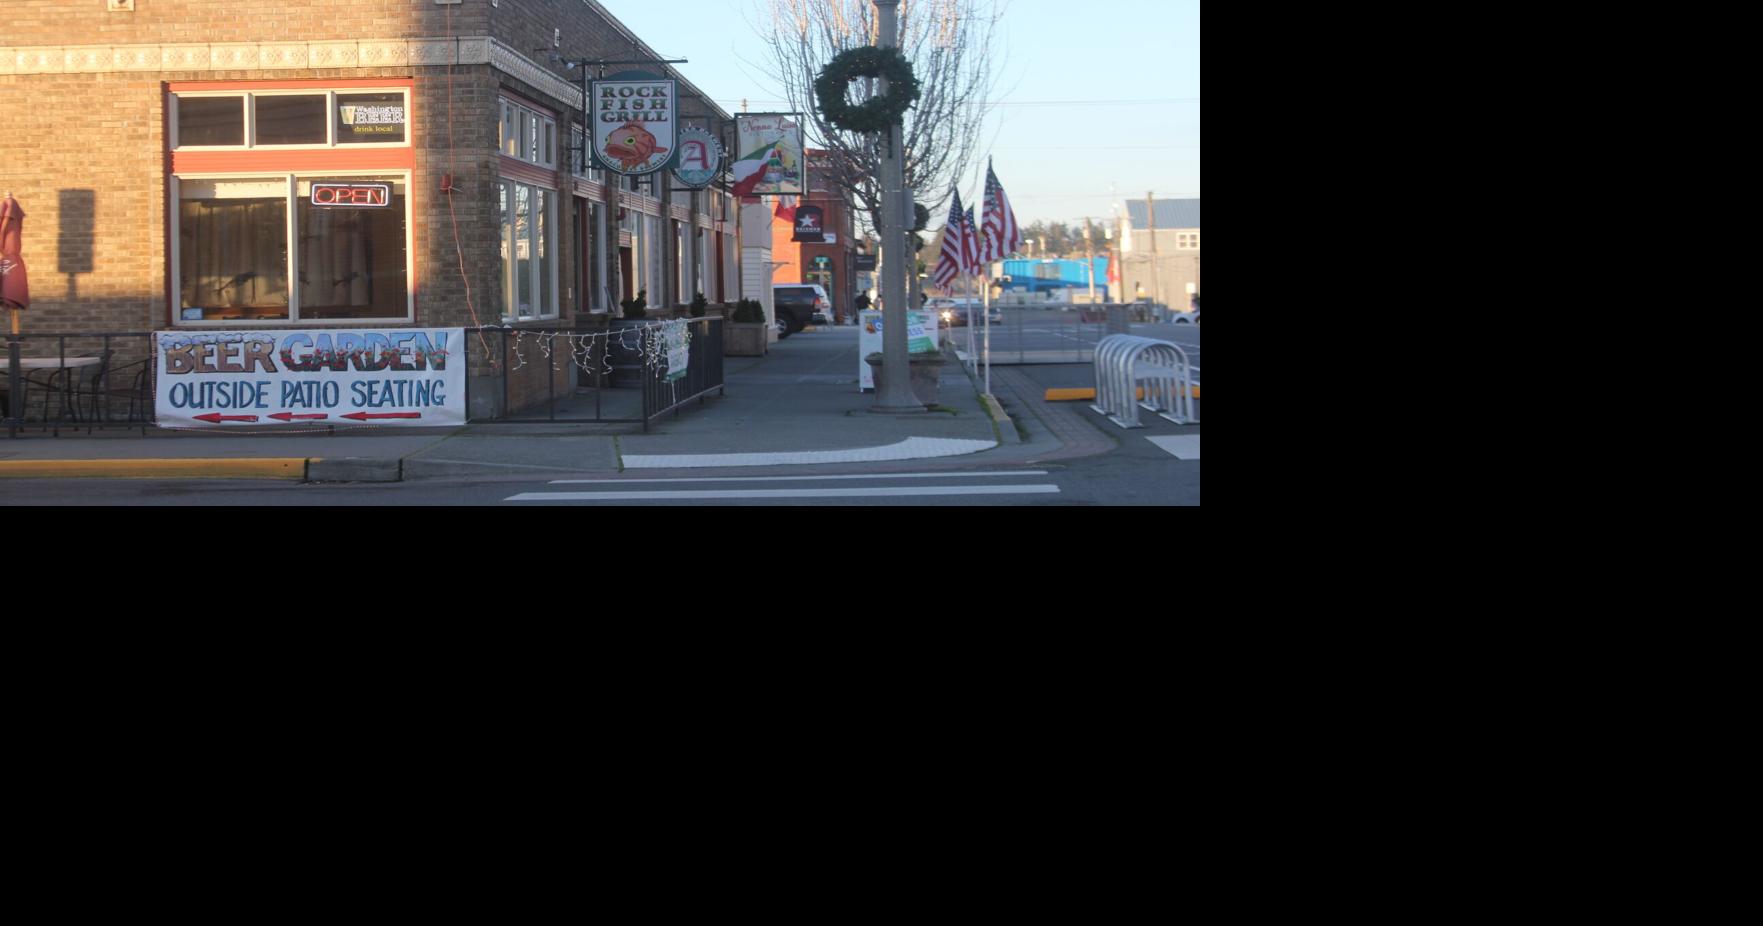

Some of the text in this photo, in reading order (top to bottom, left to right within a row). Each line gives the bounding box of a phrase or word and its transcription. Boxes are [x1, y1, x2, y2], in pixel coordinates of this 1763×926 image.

[600, 86, 667, 98] ROCK
[355, 106, 403, 114] Washington
[600, 98, 667, 110] FISH
[355, 112, 405, 124] BEER
[600, 111, 667, 122] GRILL
[315, 187, 385, 205] OPEN
[160, 332, 449, 374] BEER GARDEN
[169, 379, 446, 409] OUTSIDE PATIO SEATING
